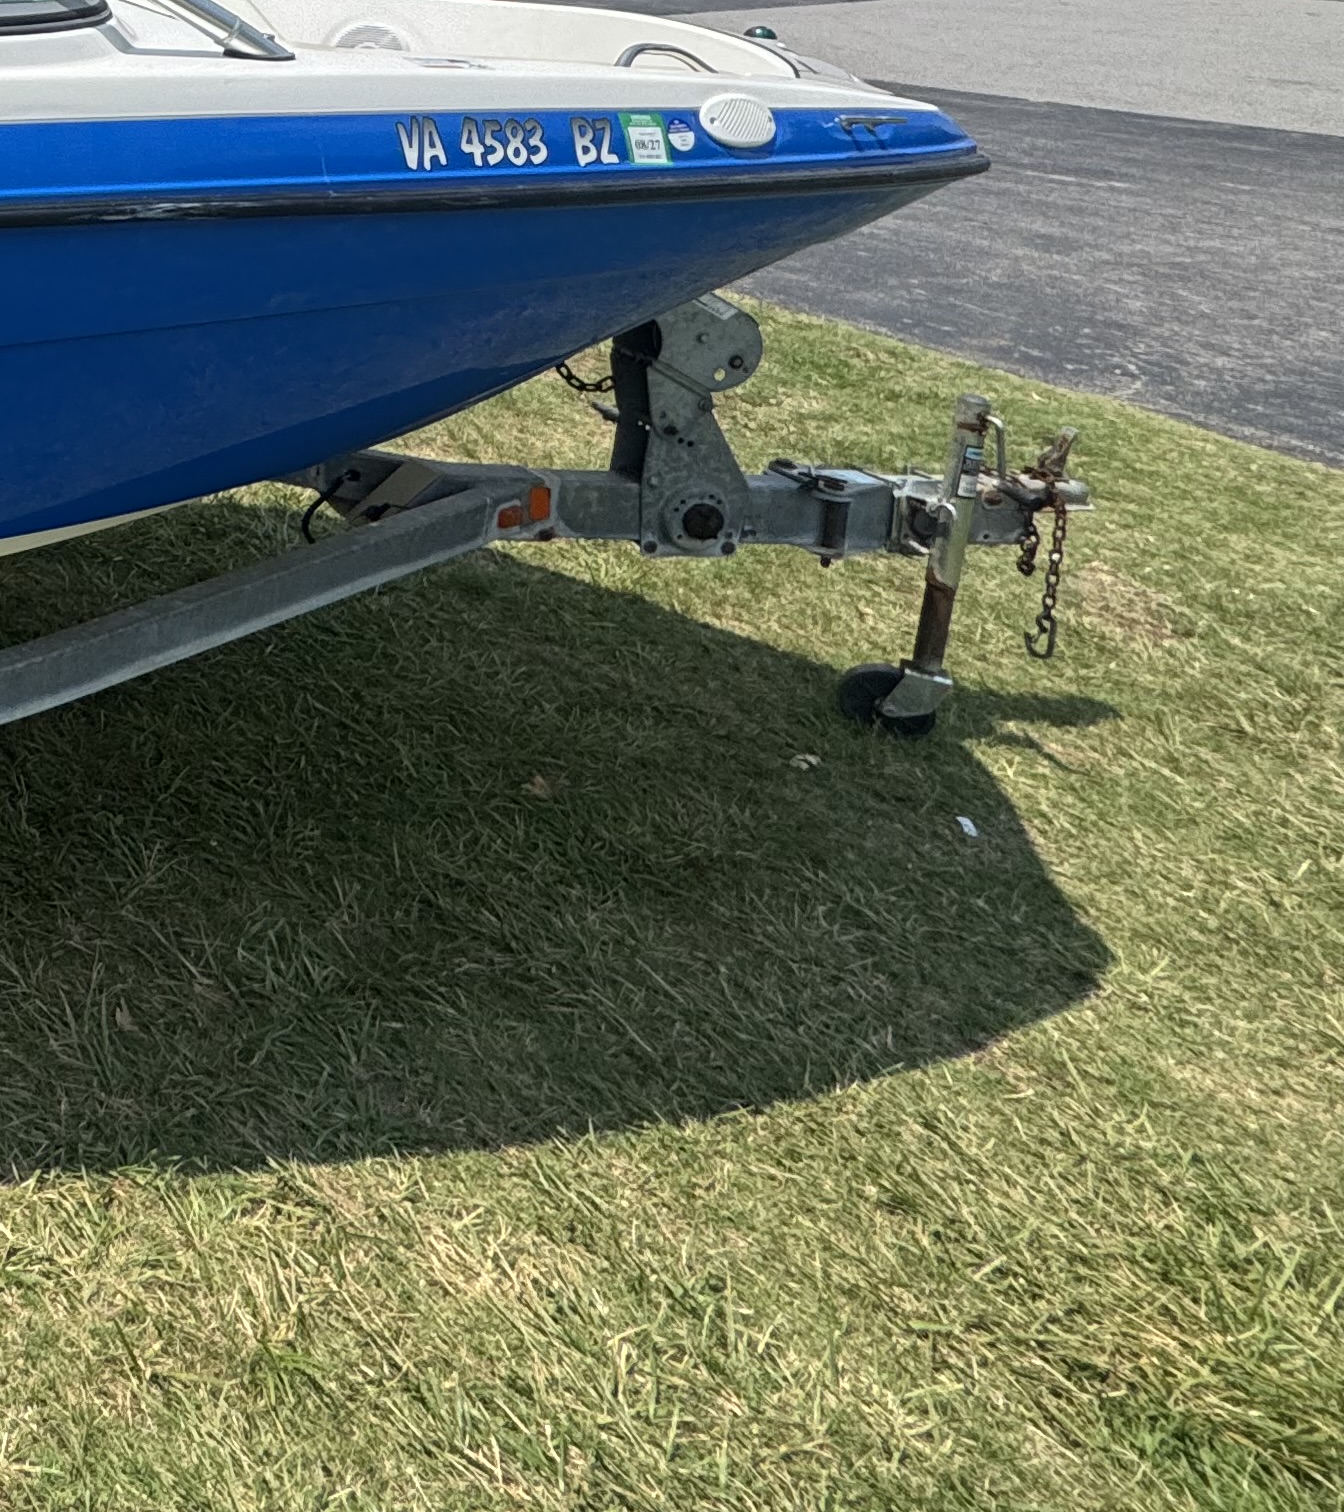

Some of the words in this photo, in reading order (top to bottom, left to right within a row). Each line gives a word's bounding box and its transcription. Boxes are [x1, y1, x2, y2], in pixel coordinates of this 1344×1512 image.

[396, 117, 447, 171] VA
[458, 117, 548, 167] 4583
[571, 117, 620, 167] BZ
